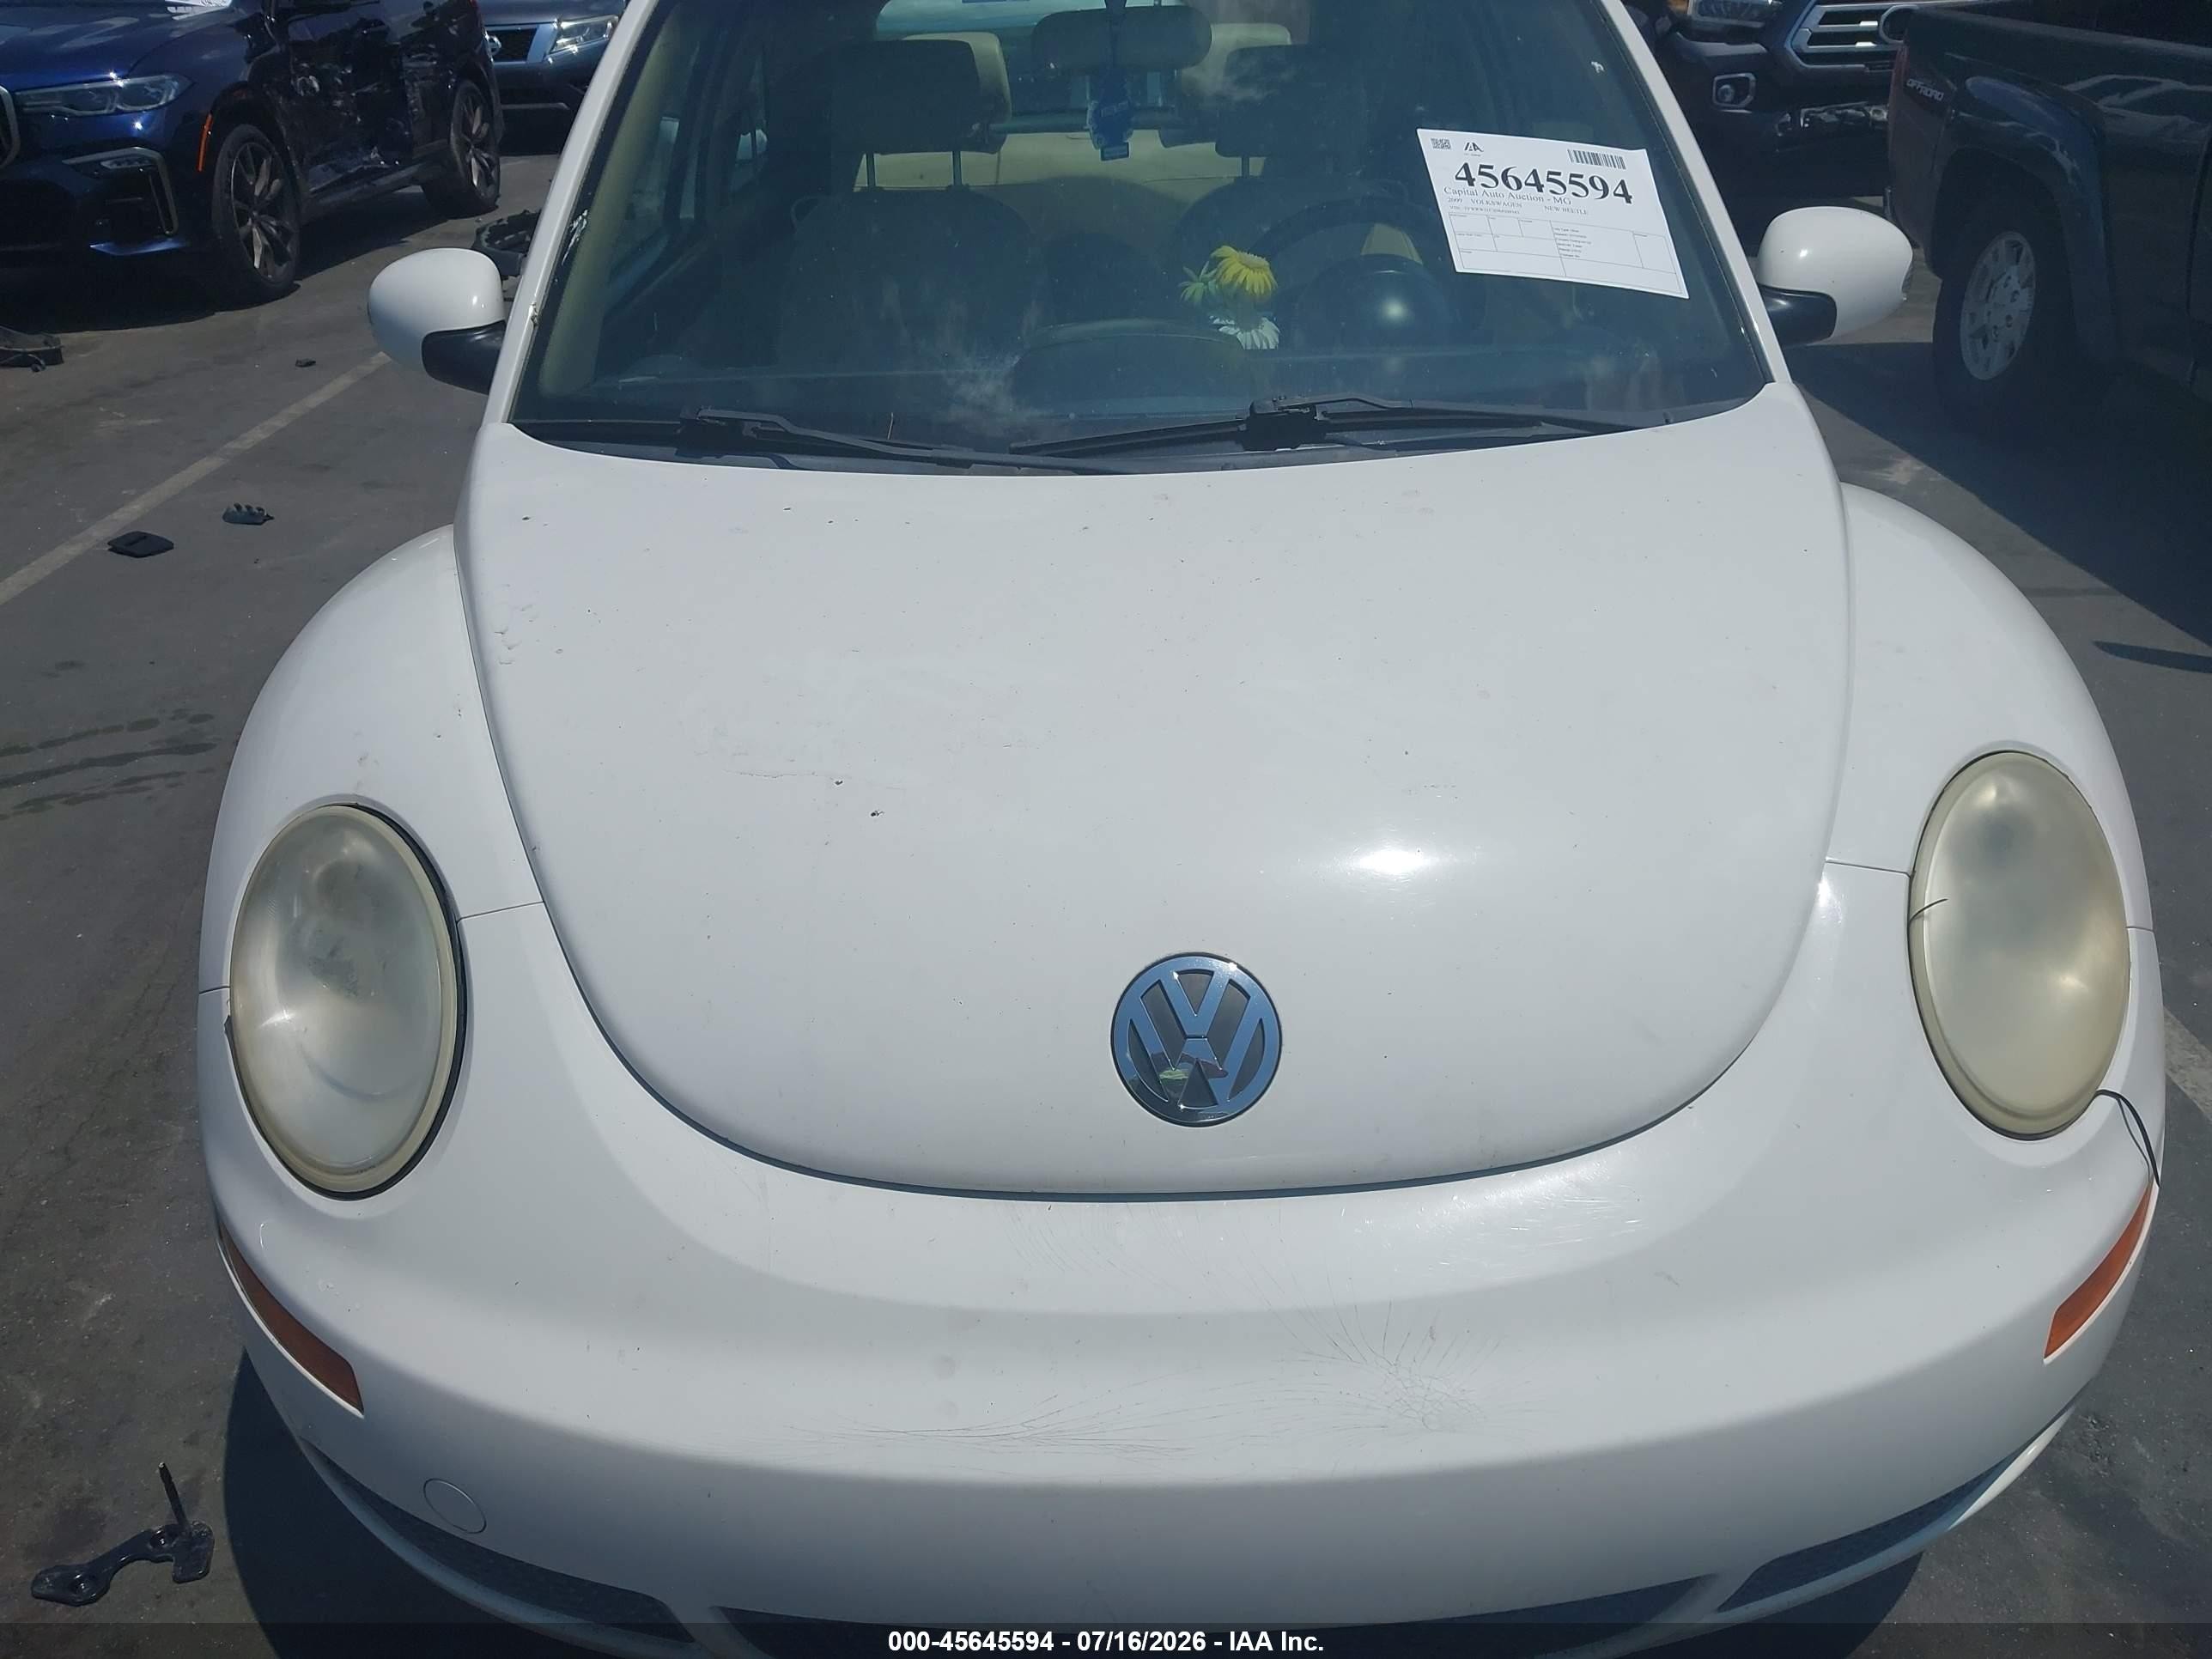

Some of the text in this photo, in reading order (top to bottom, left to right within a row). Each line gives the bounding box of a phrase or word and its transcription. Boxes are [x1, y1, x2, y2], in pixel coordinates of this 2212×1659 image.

[1455, 162, 1632, 204] 45645594
[1444, 186, 1478, 197] Capital
[1482, 190, 1504, 199] Auto
[1508, 192, 1544, 202] Auction
[1553, 197, 1571, 205] MG
[1470, 198, 1522, 208] VOLKSWAGEN
